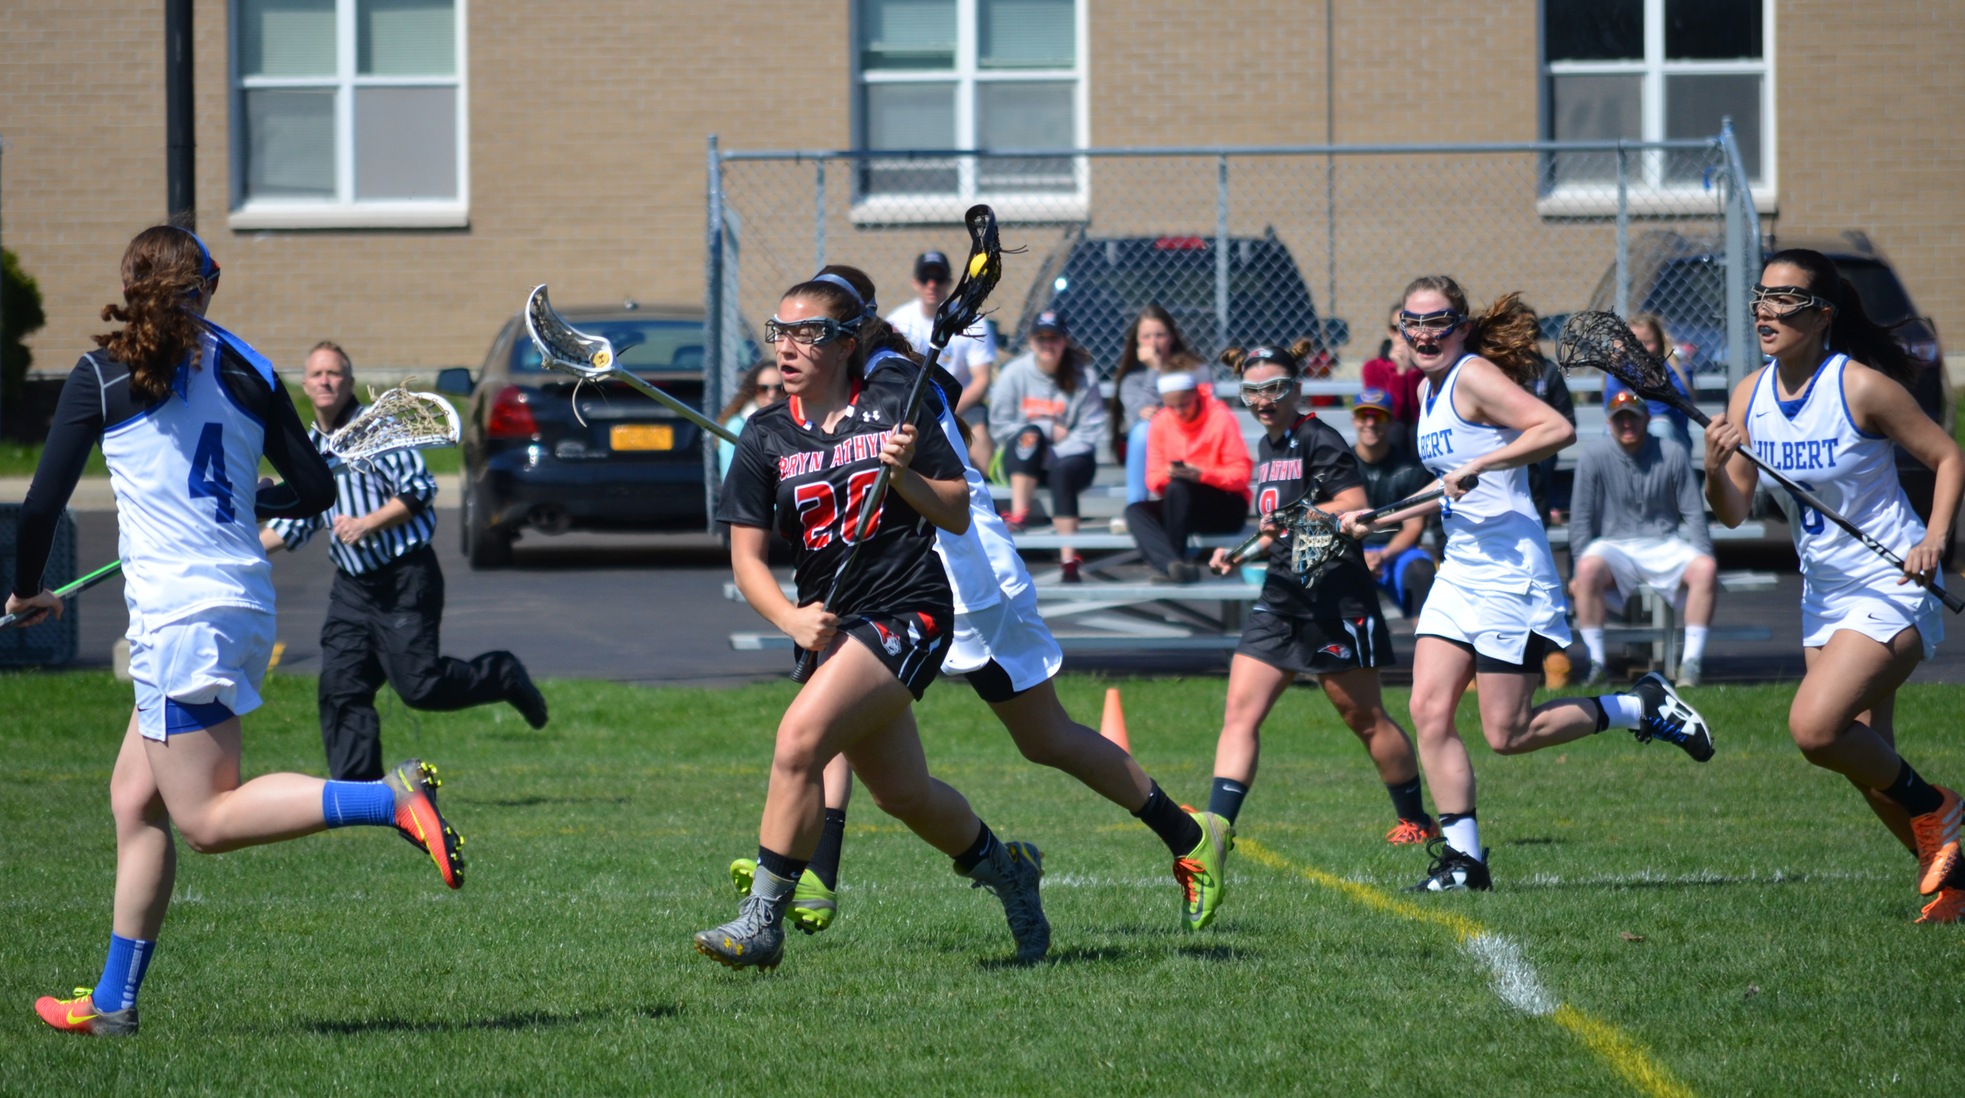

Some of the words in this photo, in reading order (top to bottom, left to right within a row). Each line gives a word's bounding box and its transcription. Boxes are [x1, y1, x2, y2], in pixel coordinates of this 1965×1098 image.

[778, 450, 825, 481] BRYN
[830, 430, 893, 469] ATHYN
[1268, 458, 1303, 482] ATHYN
[1419, 428, 1454, 461] BERT
[187, 422, 236, 524] 4
[794, 467, 889, 551] 20
